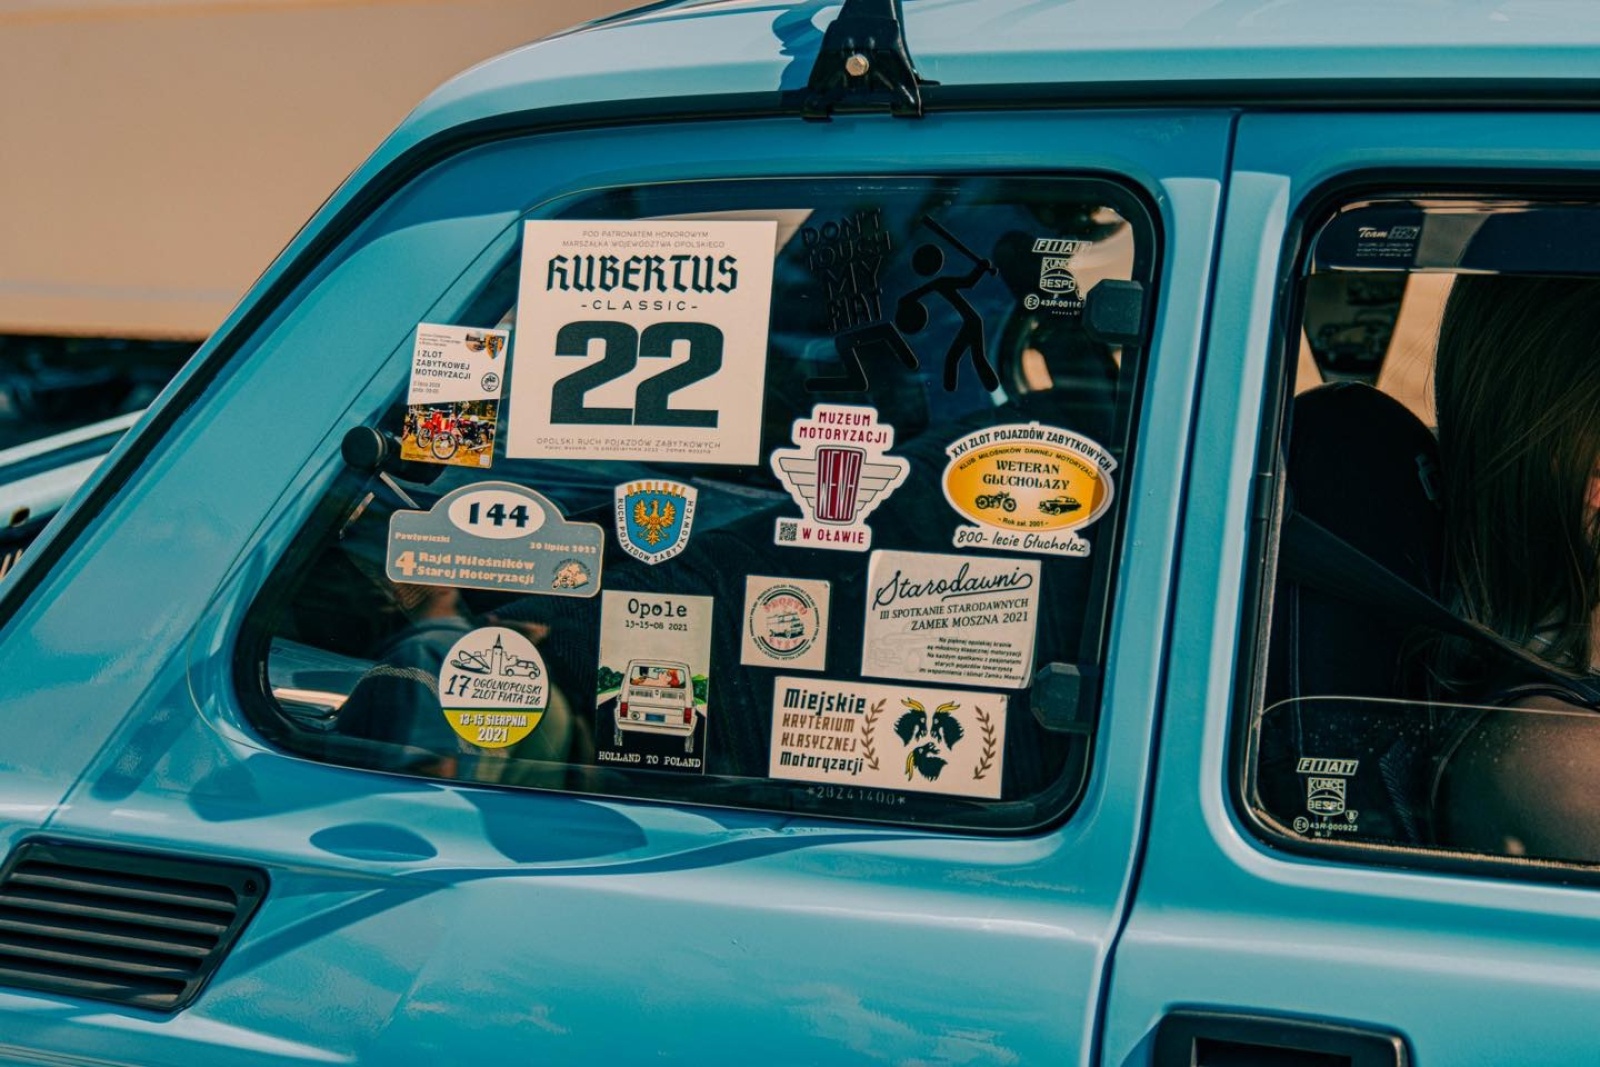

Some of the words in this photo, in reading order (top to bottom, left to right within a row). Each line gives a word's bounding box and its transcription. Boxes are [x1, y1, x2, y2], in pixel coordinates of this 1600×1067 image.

[582, 230, 600, 238] POD
[601, 230, 653, 238] PATRONATEM
[655, 230, 709, 238] HONOROWYM
[1358, 227, 1388, 238] Team
[546, 254, 738, 293] HUBERTUS
[422, 350, 443, 358] ZLOT
[415, 369, 471, 380] MOTORYZACJI
[416, 359, 470, 370] ZABYTKOWEJ
[550, 320, 724, 428] 22
[818, 411, 871, 427] MUZEUM
[536, 437, 574, 445] OPOLSKI
[577, 438, 601, 446] RUCH
[655, 440, 721, 449] ZABYTKOWYCH
[799, 426, 888, 444] MOTORYZACJI
[951, 441, 968, 458] XXI
[969, 433, 991, 449] ZLOT
[994, 427, 1045, 441] POJAZDÓW
[1046, 431, 1113, 472] ZABYTKOWYCH
[959, 458, 977, 472] KLUB
[1024, 447, 1053, 458] DAWNEJ
[996, 459, 1061, 474] WETERAN
[468, 501, 530, 528] 144
[654, 500, 694, 562] ZABYTKOWYCH
[802, 527, 812, 540] W
[817, 528, 865, 544] OŁAWIE
[992, 531, 1020, 547] lecie
[1023, 533, 1086, 552] Głuchołaz
[395, 551, 417, 577] 4
[419, 552, 451, 565] Rajd
[417, 565, 456, 580] Starej
[459, 568, 535, 585] Motoryzacji
[872, 562, 1034, 611] Starodawni
[628, 598, 688, 619] Opole
[880, 610, 890, 620] III
[892, 605, 945, 619] SPOTKANIE
[947, 598, 1029, 615] STARODAWNYCH
[668, 622, 688, 632] 2021
[911, 617, 949, 631] ZAMEK
[952, 614, 999, 628] MOSZNA
[1003, 611, 1029, 624] 2021
[444, 674, 473, 697] 17
[471, 688, 496, 700] ZLOT
[498, 692, 523, 704] FIATA
[524, 696, 541, 705] 126
[783, 688, 867, 716] Miejskie
[487, 714, 528, 727] SIERPNIA
[782, 712, 855, 733] KRYTERIUM
[478, 727, 509, 743] 2021
[781, 731, 857, 753] KLASYCZNEJ
[598, 751, 641, 764] HOLLAND
[646, 755, 660, 765] TO
[664, 756, 702, 768] POLAND
[779, 750, 864, 776] Motoryzacji
[1299, 759, 1357, 774] FIAT
